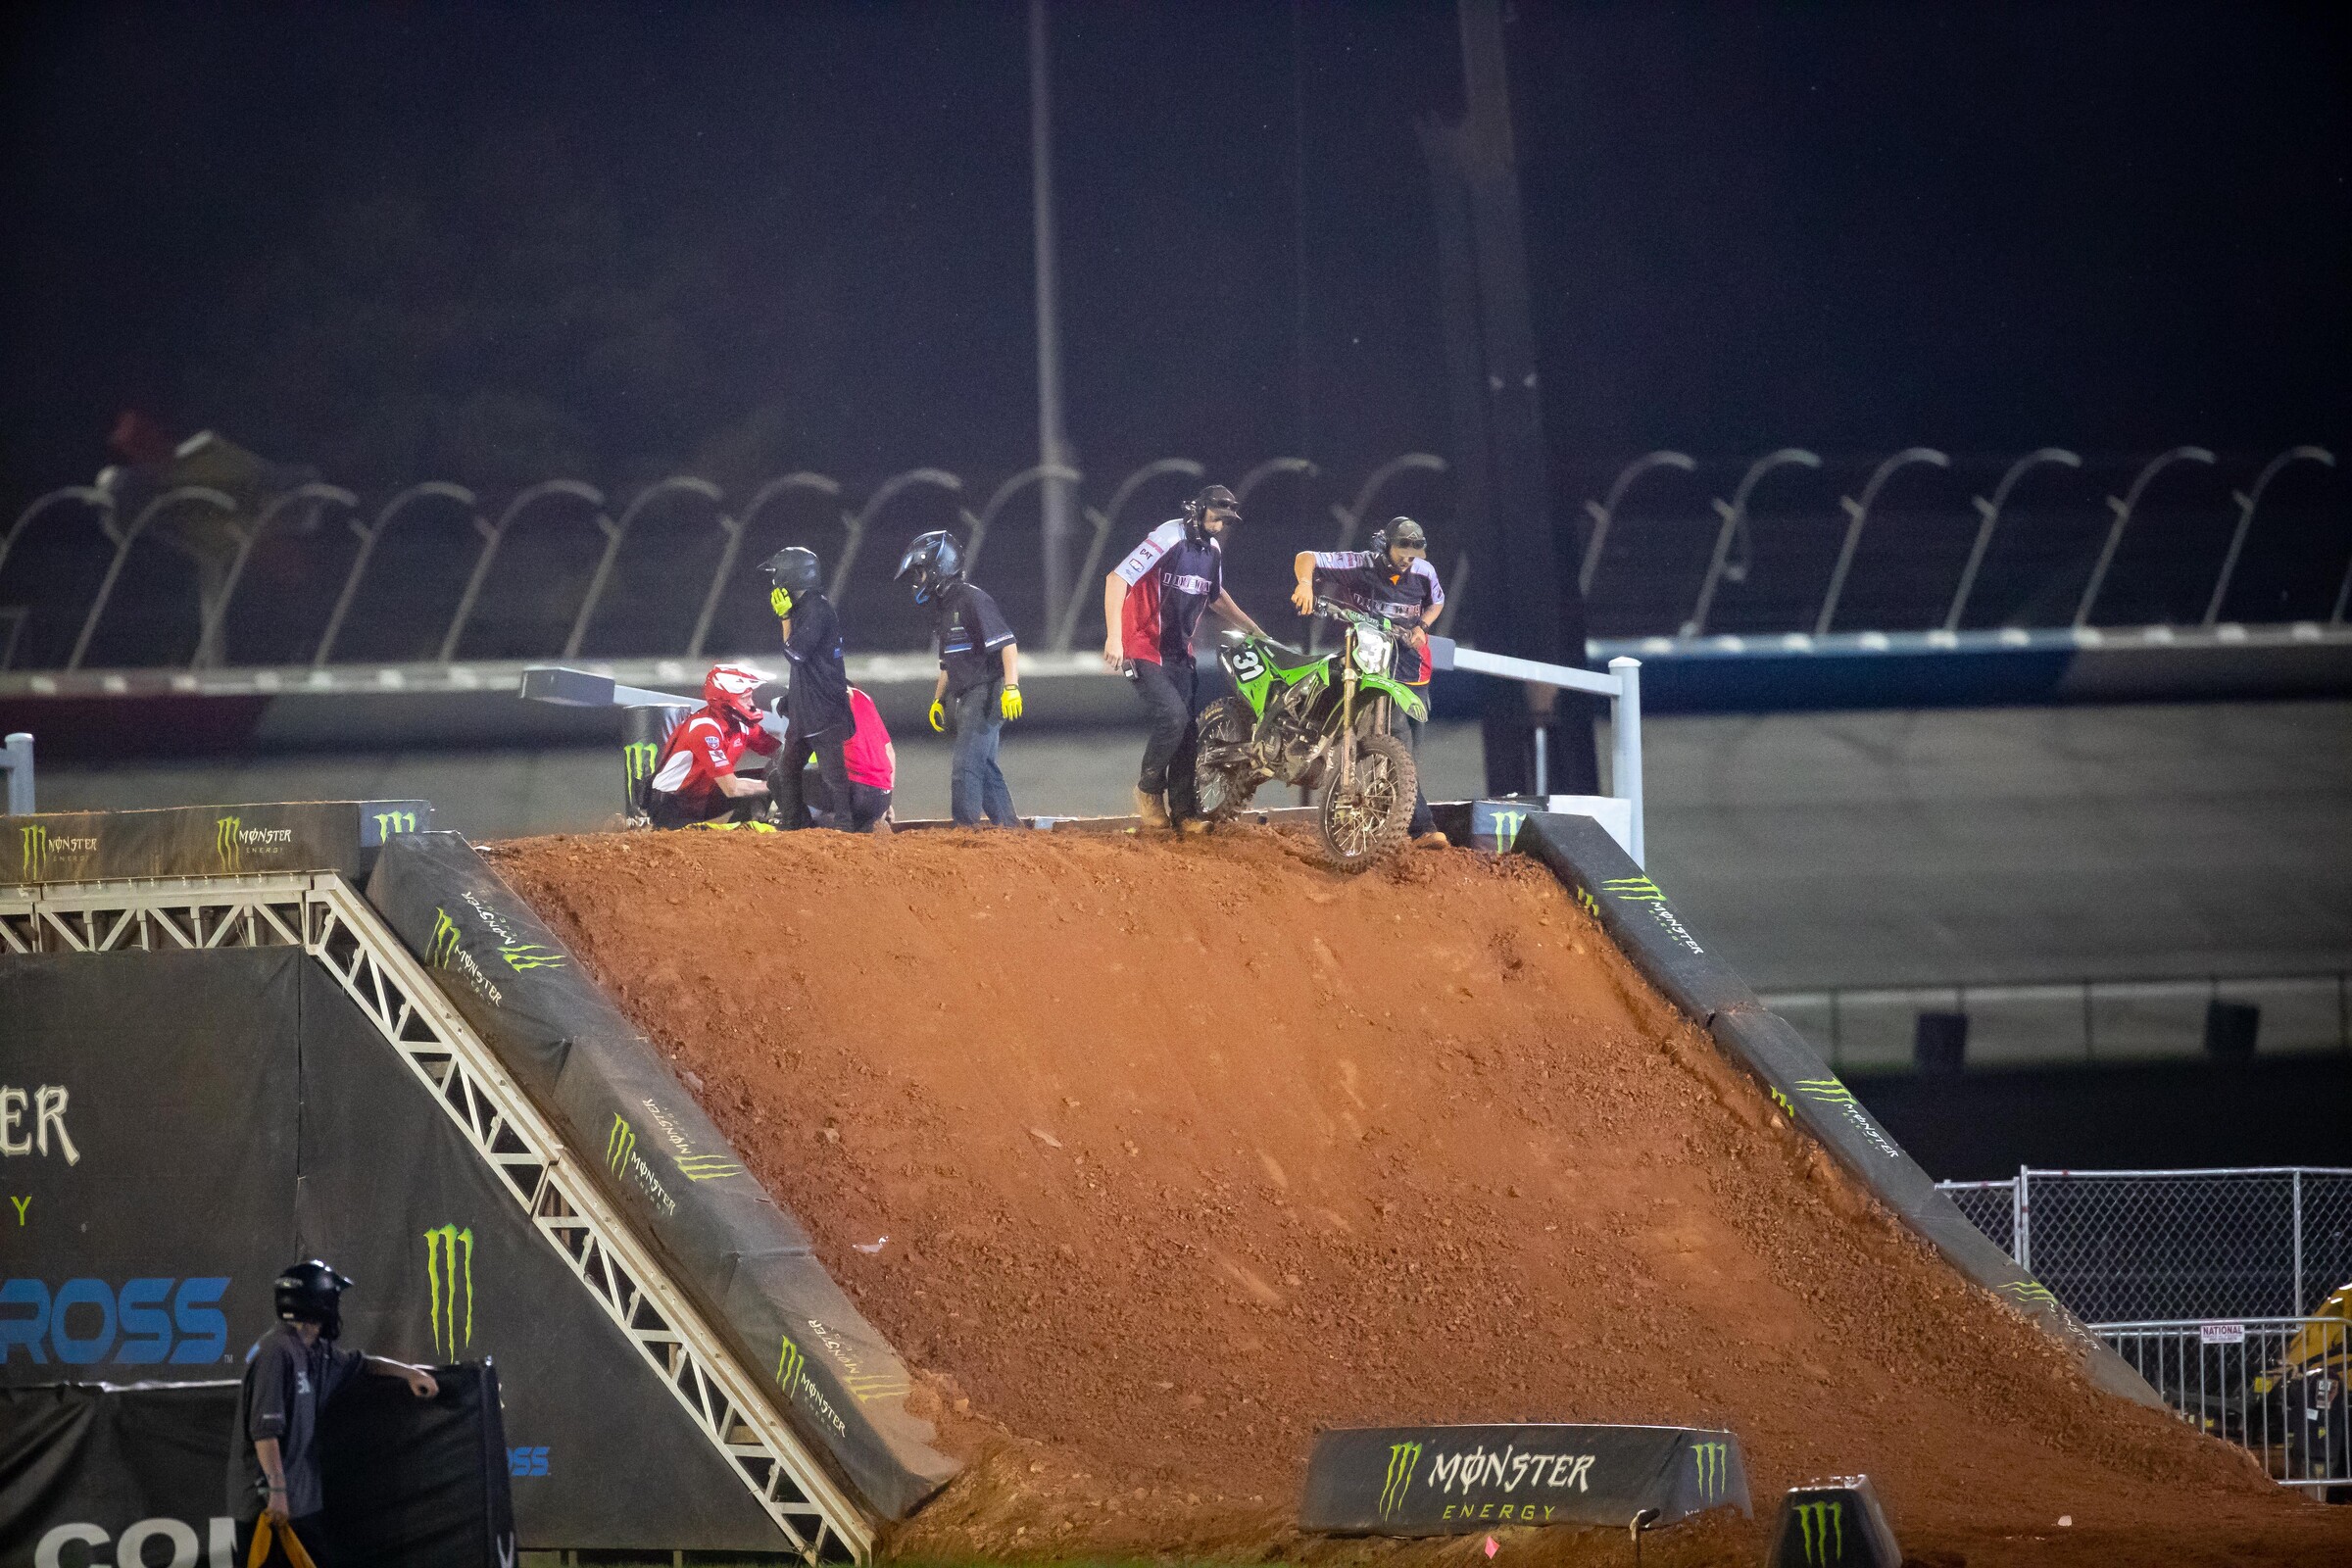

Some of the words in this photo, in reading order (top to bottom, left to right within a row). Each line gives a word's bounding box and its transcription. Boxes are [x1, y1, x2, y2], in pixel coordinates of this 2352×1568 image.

[1140, 549, 1153, 560] CAT
[1233, 651, 1265, 681] 31
[238, 828, 292, 845] MONSTER
[1650, 902, 1704, 955] MONSTER
[0, 1277, 231, 1364] ROSS
[2202, 1325, 2243, 1335] NATIONAL
[1427, 1444, 1596, 1495] MONSTER
[1442, 1502, 1556, 1520] ENERGY
